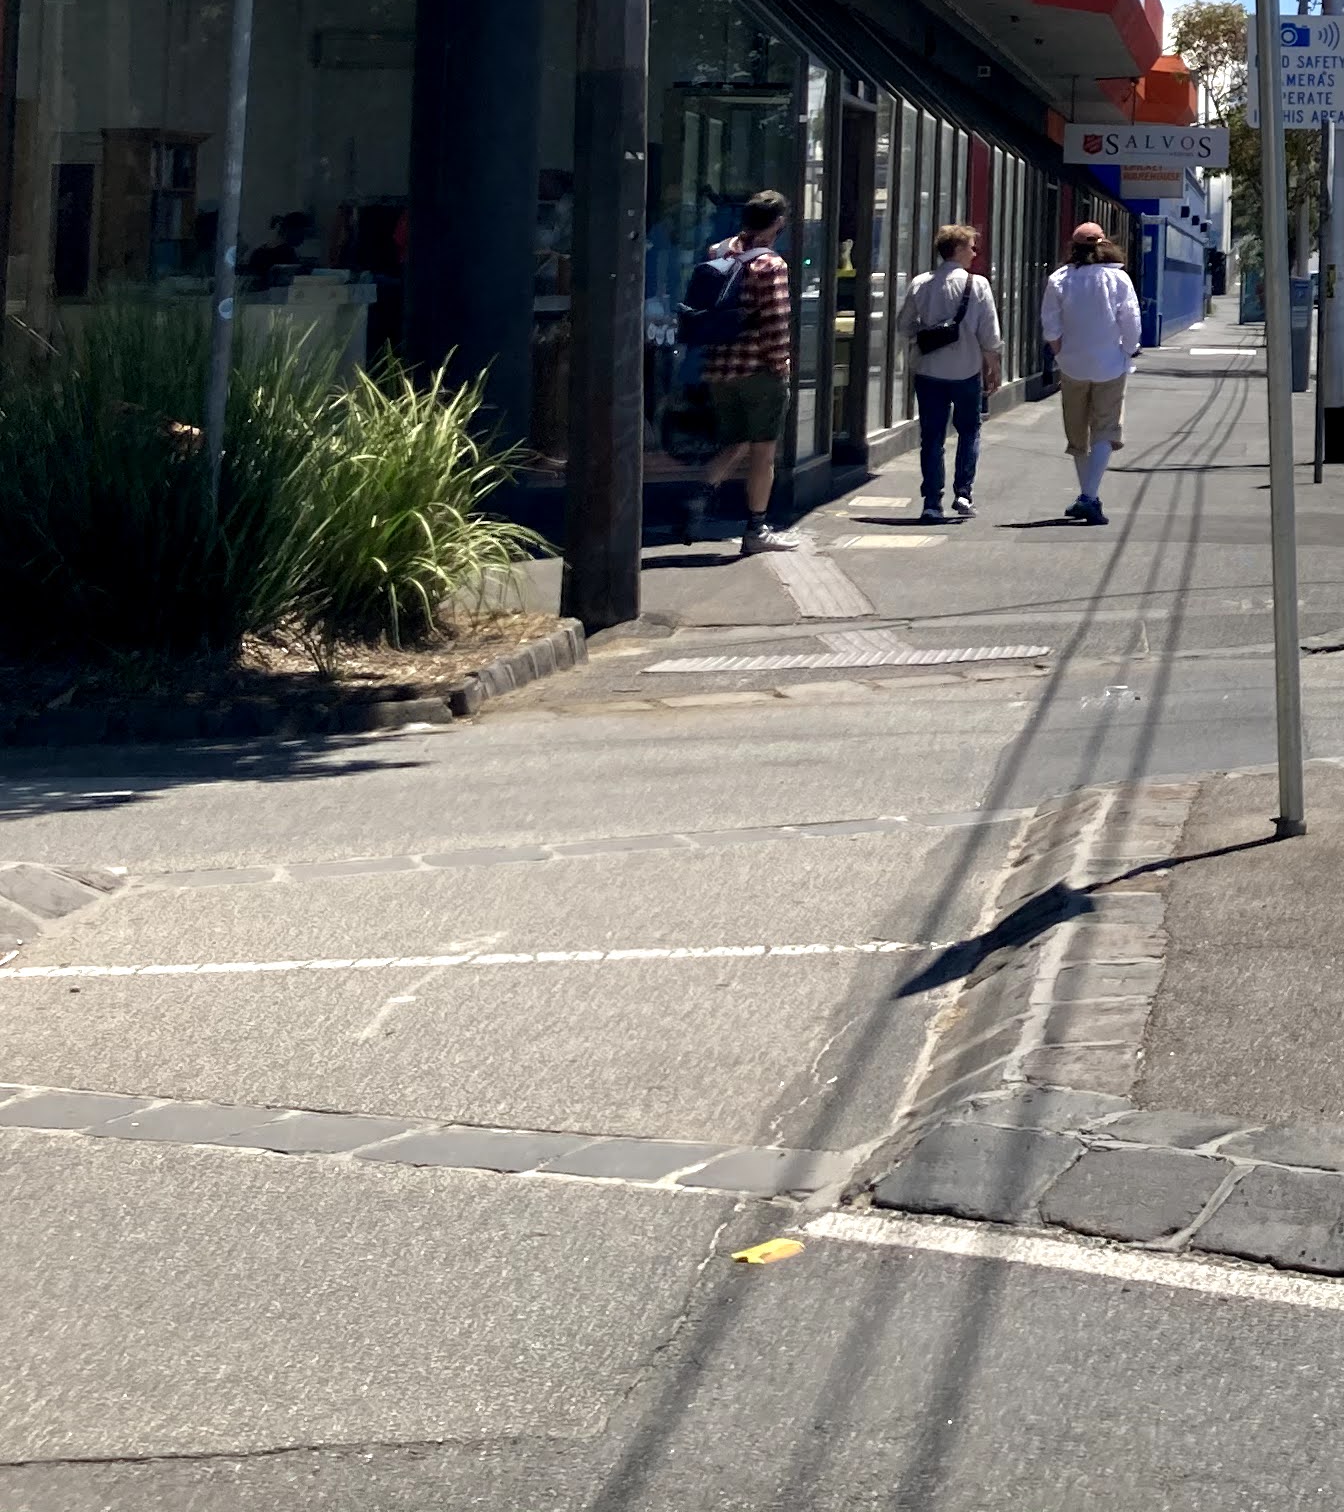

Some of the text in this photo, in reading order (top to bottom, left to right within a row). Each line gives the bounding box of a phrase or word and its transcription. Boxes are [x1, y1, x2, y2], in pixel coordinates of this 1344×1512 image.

[1284, 73, 1336, 87] MERAS
[1283, 91, 1333, 105] ERATE
[1284, 109, 1304, 124] HIS
[1105, 133, 1211, 158] SALVOS
